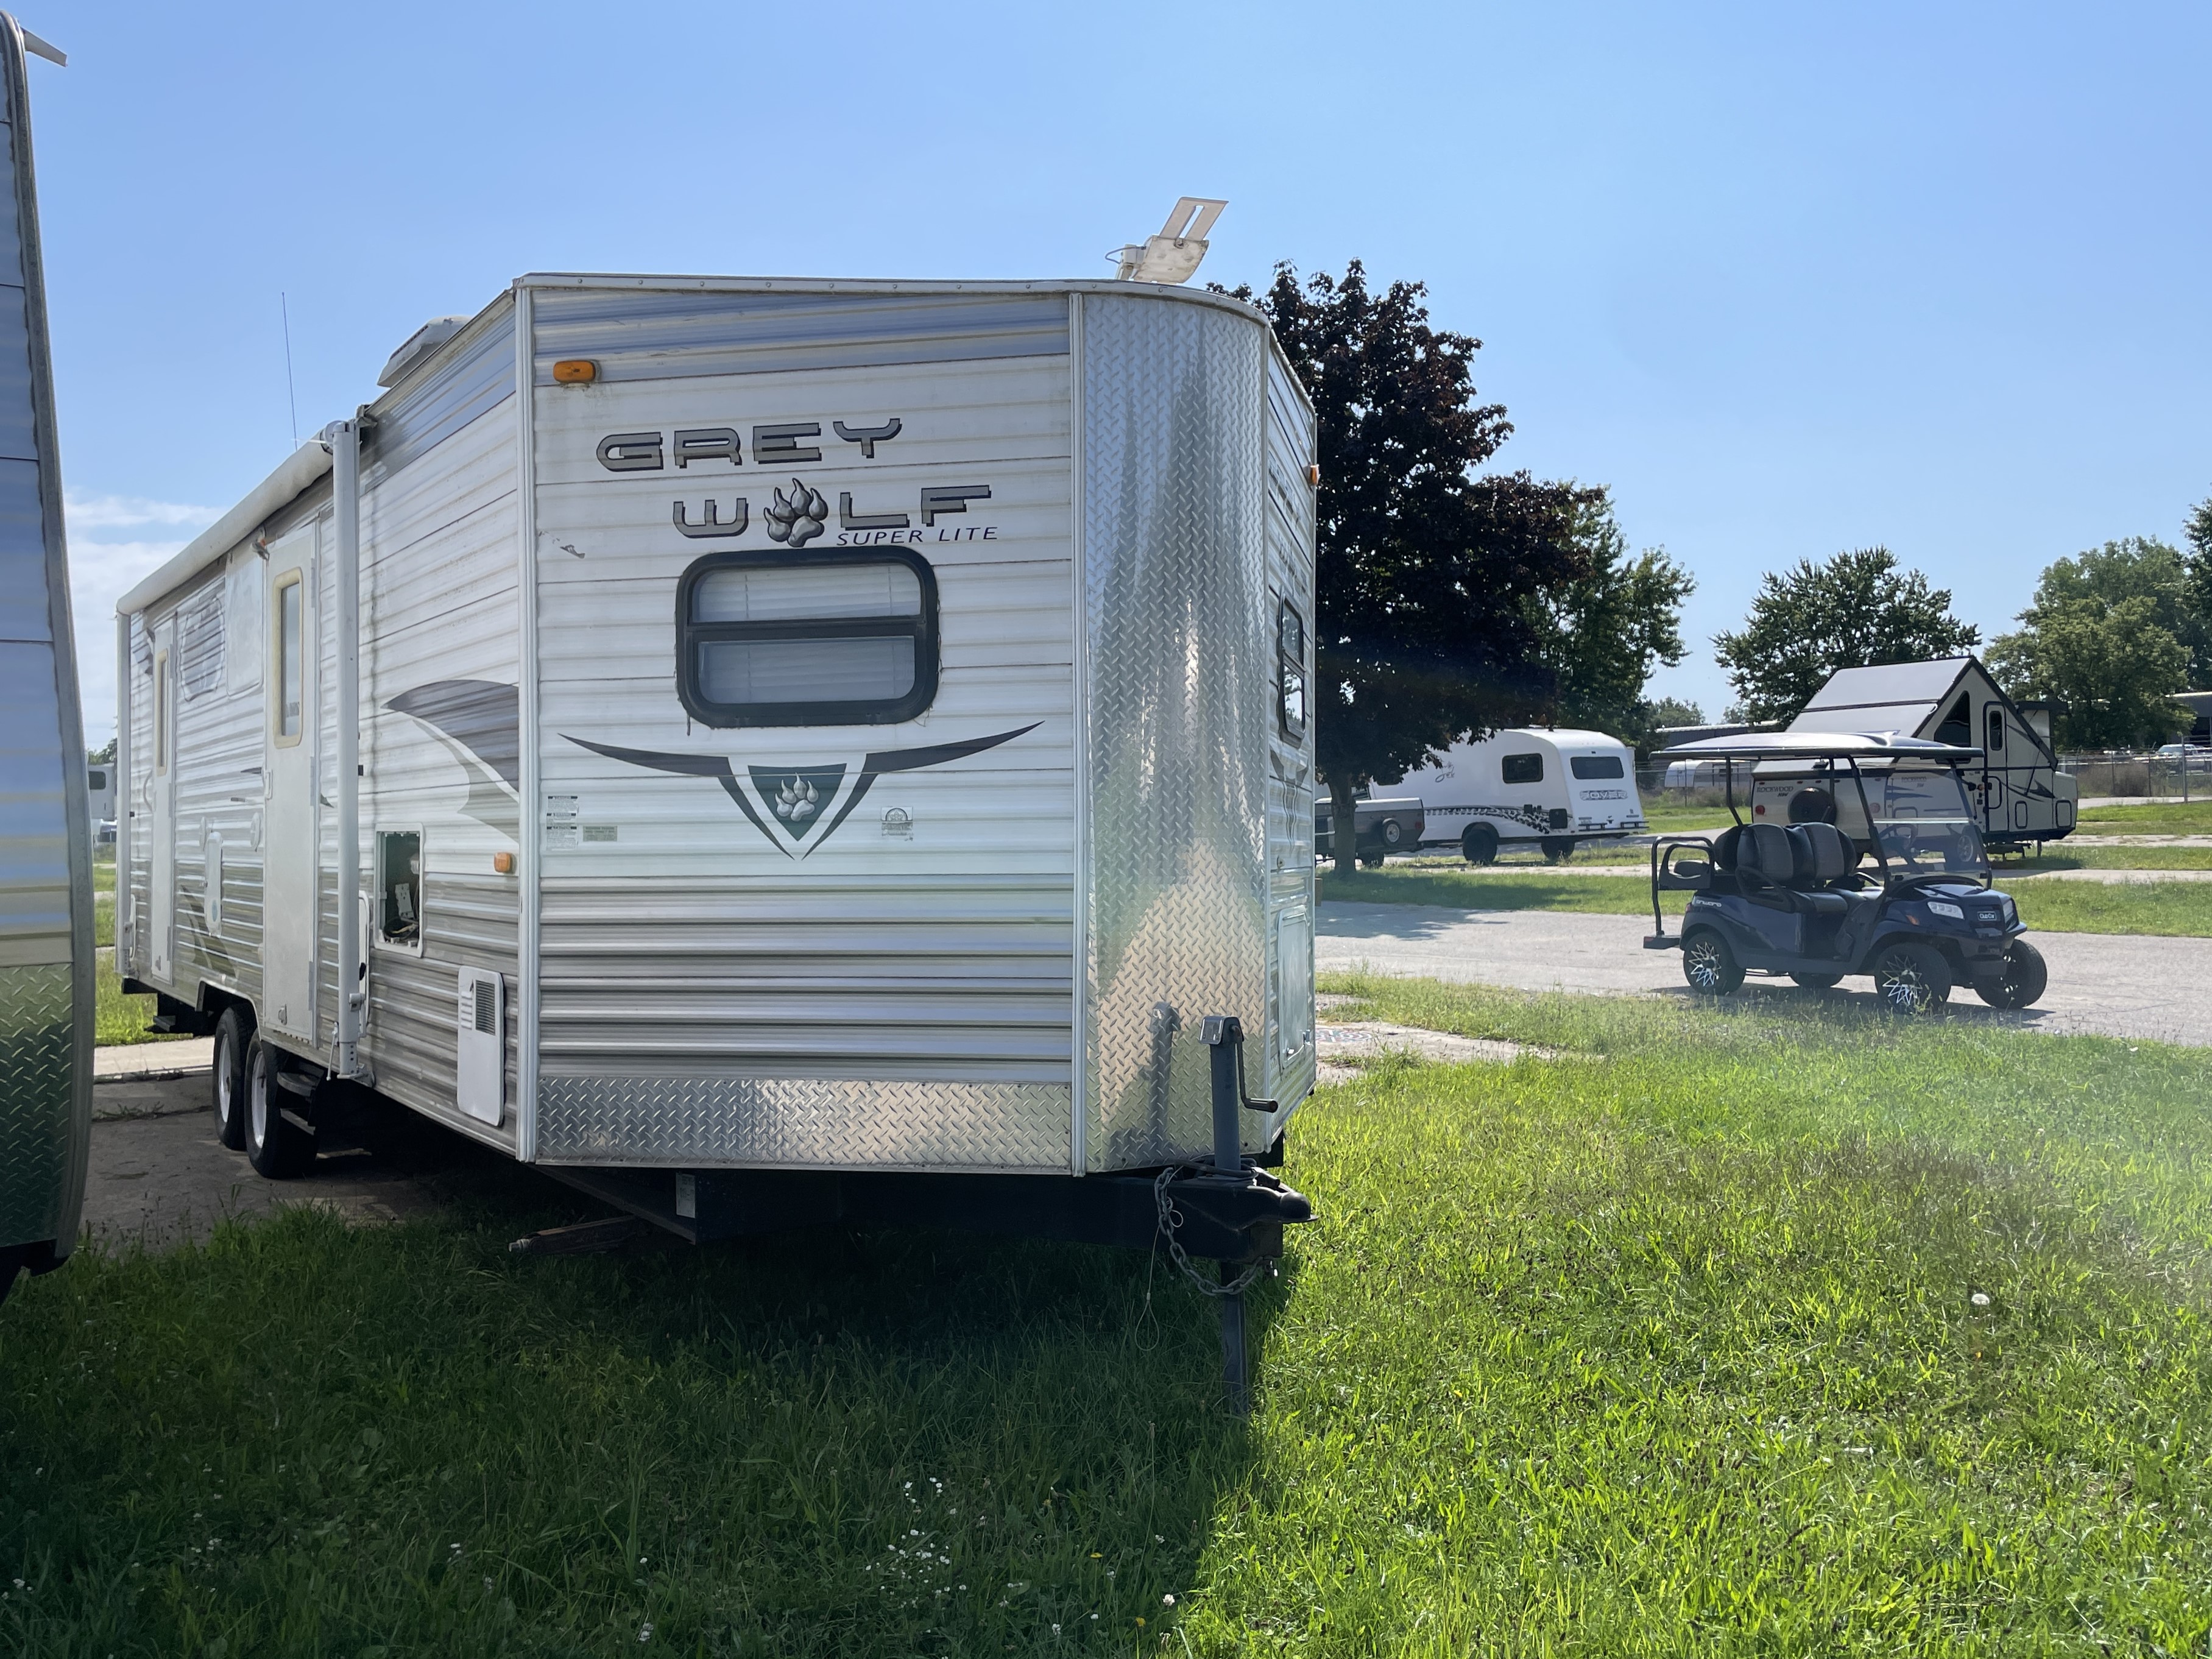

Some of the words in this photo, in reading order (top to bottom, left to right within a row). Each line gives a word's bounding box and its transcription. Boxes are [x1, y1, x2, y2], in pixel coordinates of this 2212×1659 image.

[596, 418, 902, 472] GREY
[836, 529, 924, 546] SUPER
[938, 526, 998, 542] LITE
